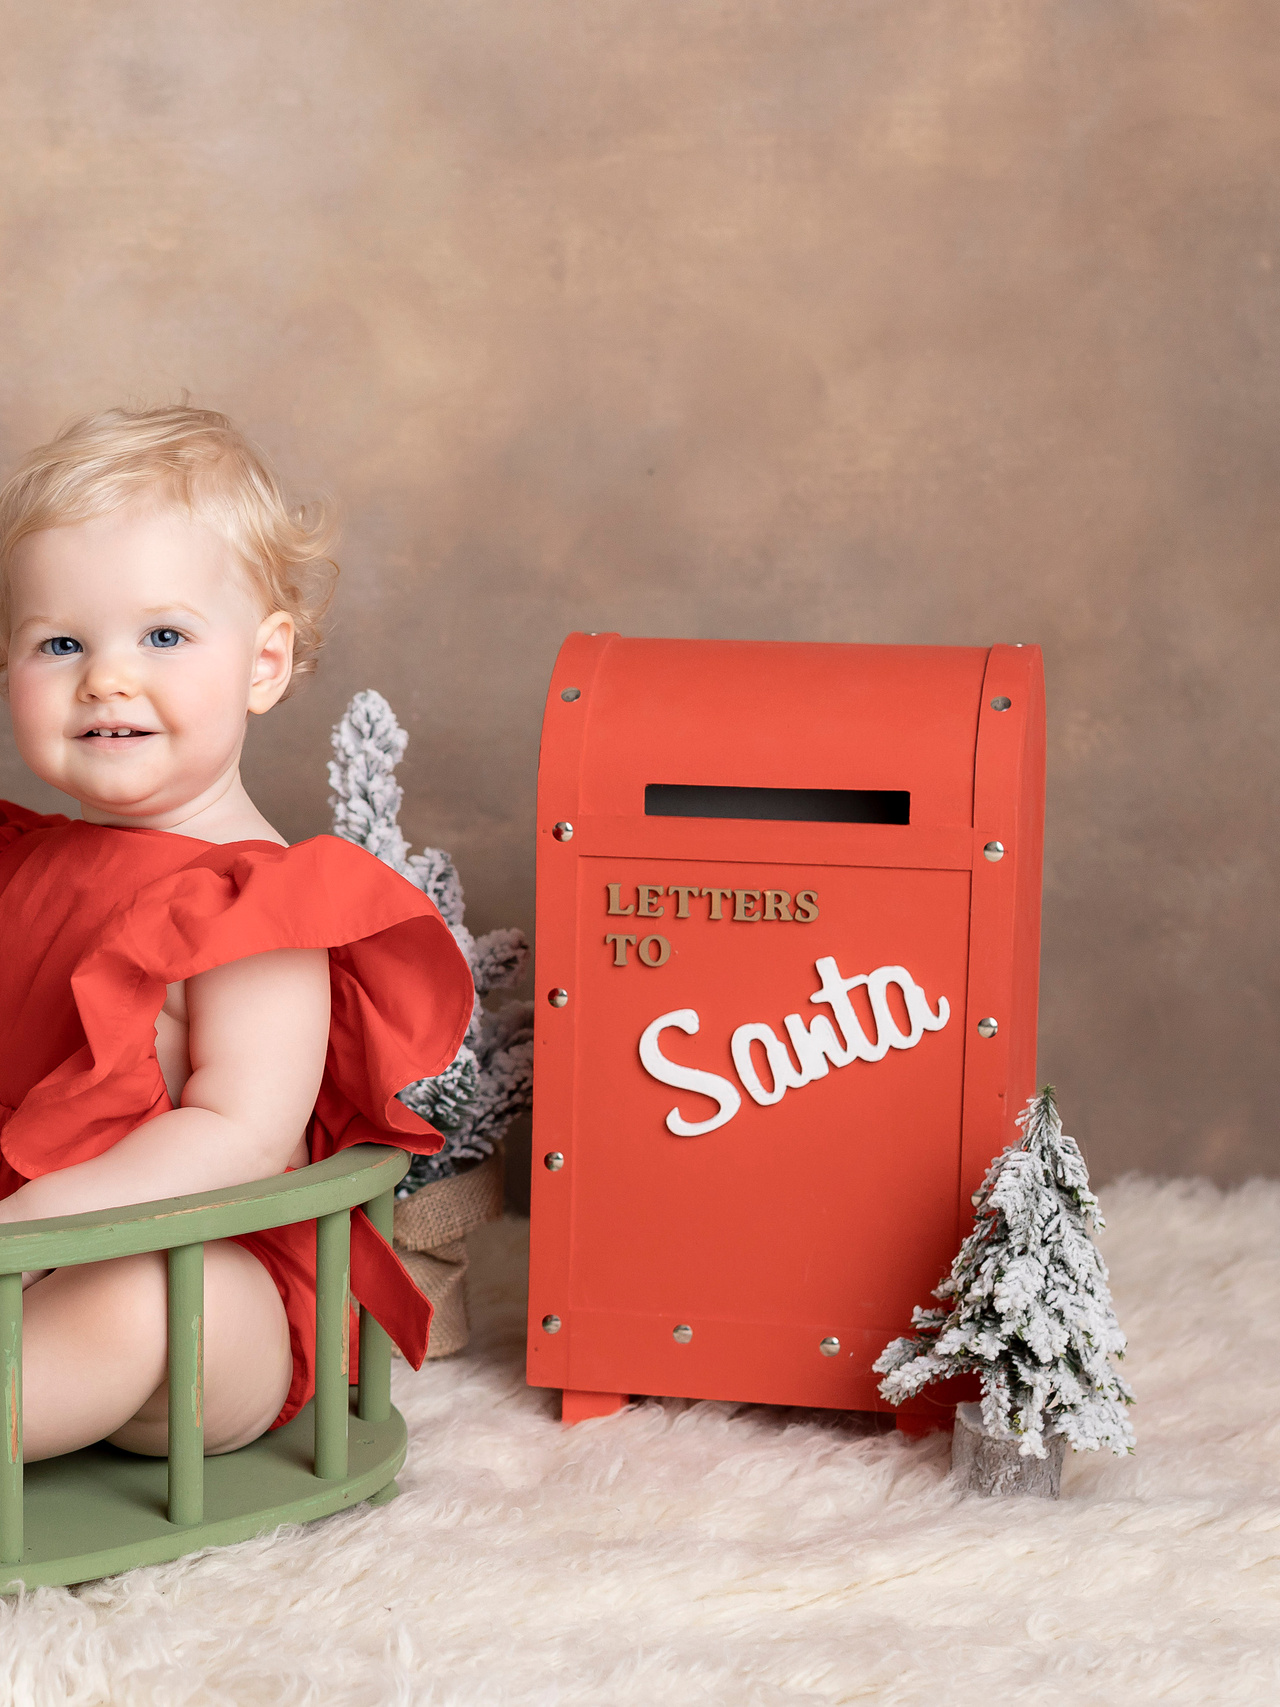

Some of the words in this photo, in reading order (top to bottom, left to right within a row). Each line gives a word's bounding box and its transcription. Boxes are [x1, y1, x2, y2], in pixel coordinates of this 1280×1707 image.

[605, 882, 820, 923] LETTERS
[605, 933, 672, 968] TO
[638, 955, 951, 1137] Santa
